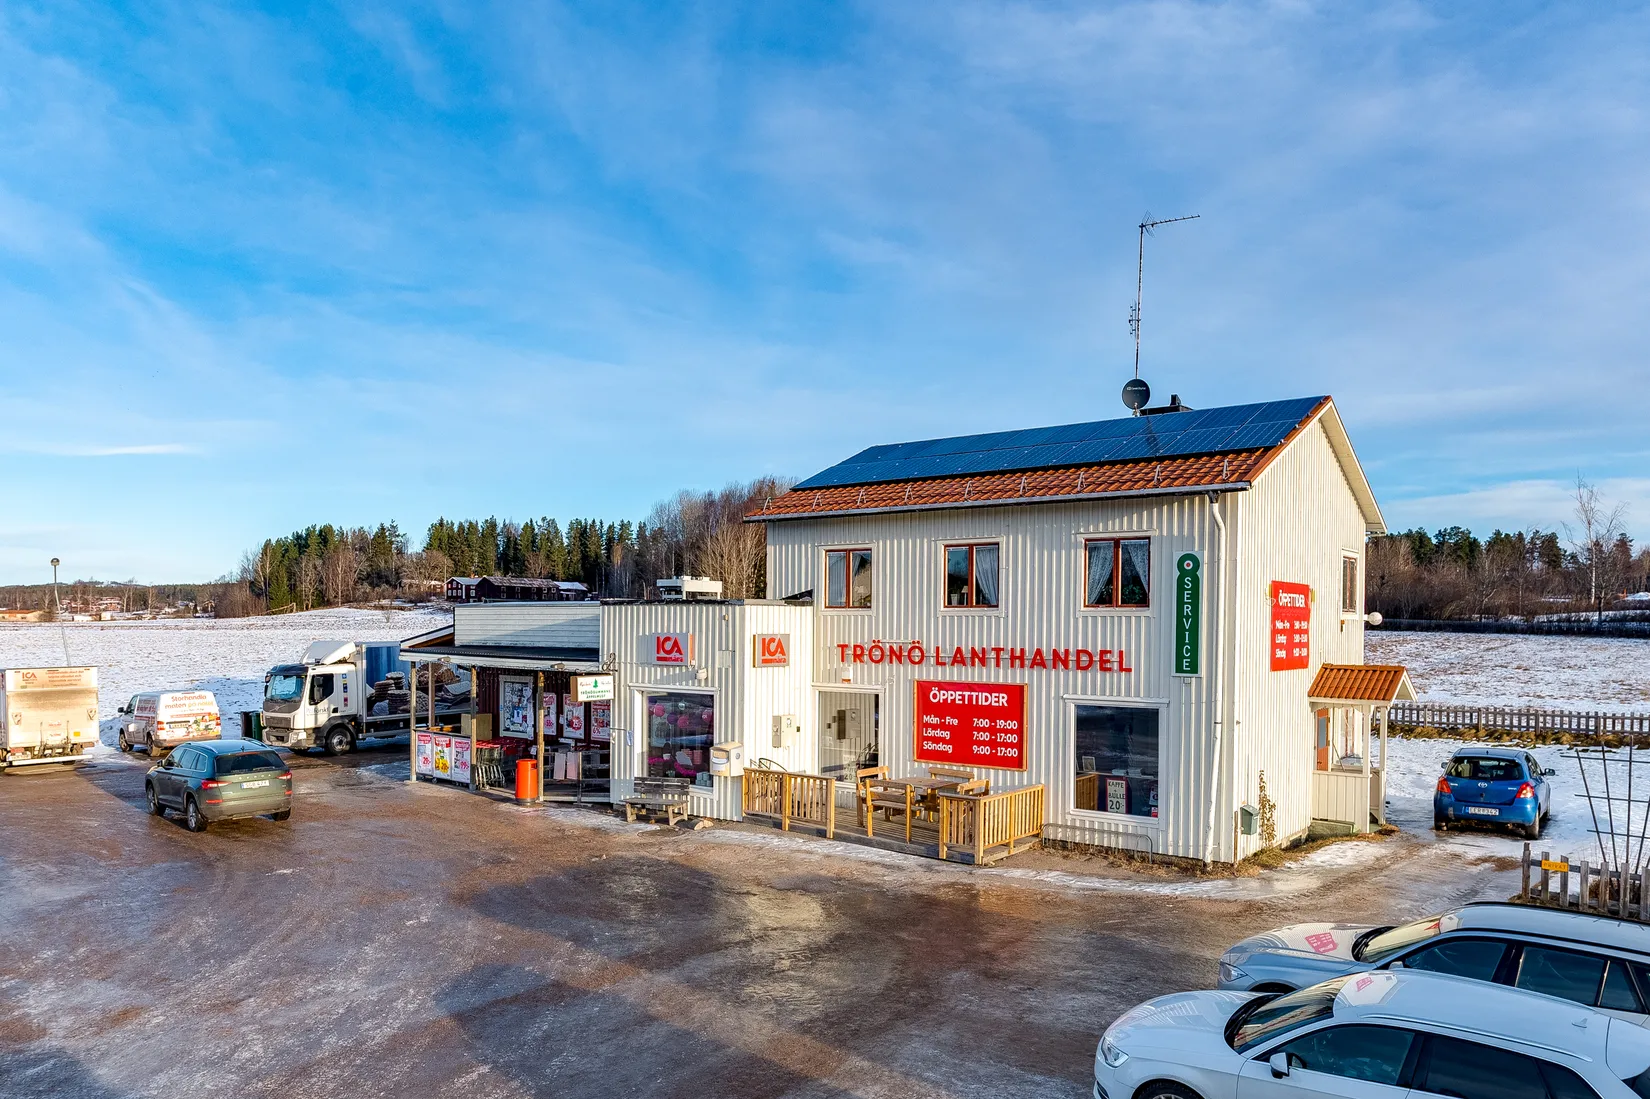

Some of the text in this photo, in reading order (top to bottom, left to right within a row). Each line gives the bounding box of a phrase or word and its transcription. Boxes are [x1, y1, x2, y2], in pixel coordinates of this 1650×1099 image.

[1183, 577, 1192, 671] SERVICE
[656, 636, 684, 655] ICA
[761, 637, 787, 657] ICA
[837, 639, 1133, 673] TRÖNÖ LANTHANDEL
[929, 687, 1008, 707] ÖPPETTIDER
[923, 714, 940, 725] Mån
[945, 716, 958, 726] Fre
[972, 718, 990, 728] 7:00
[996, 720, 1018, 730] 19:00
[923, 728, 950, 740] Lördag
[972, 731, 990, 741] 7:00
[996, 733, 1018, 743] 17:00
[923, 741, 953, 754] Söndag
[972, 745, 990, 755] 9:00
[997, 747, 1018, 757] 17:00
[1543, 862, 1566, 870] PRIVAT
